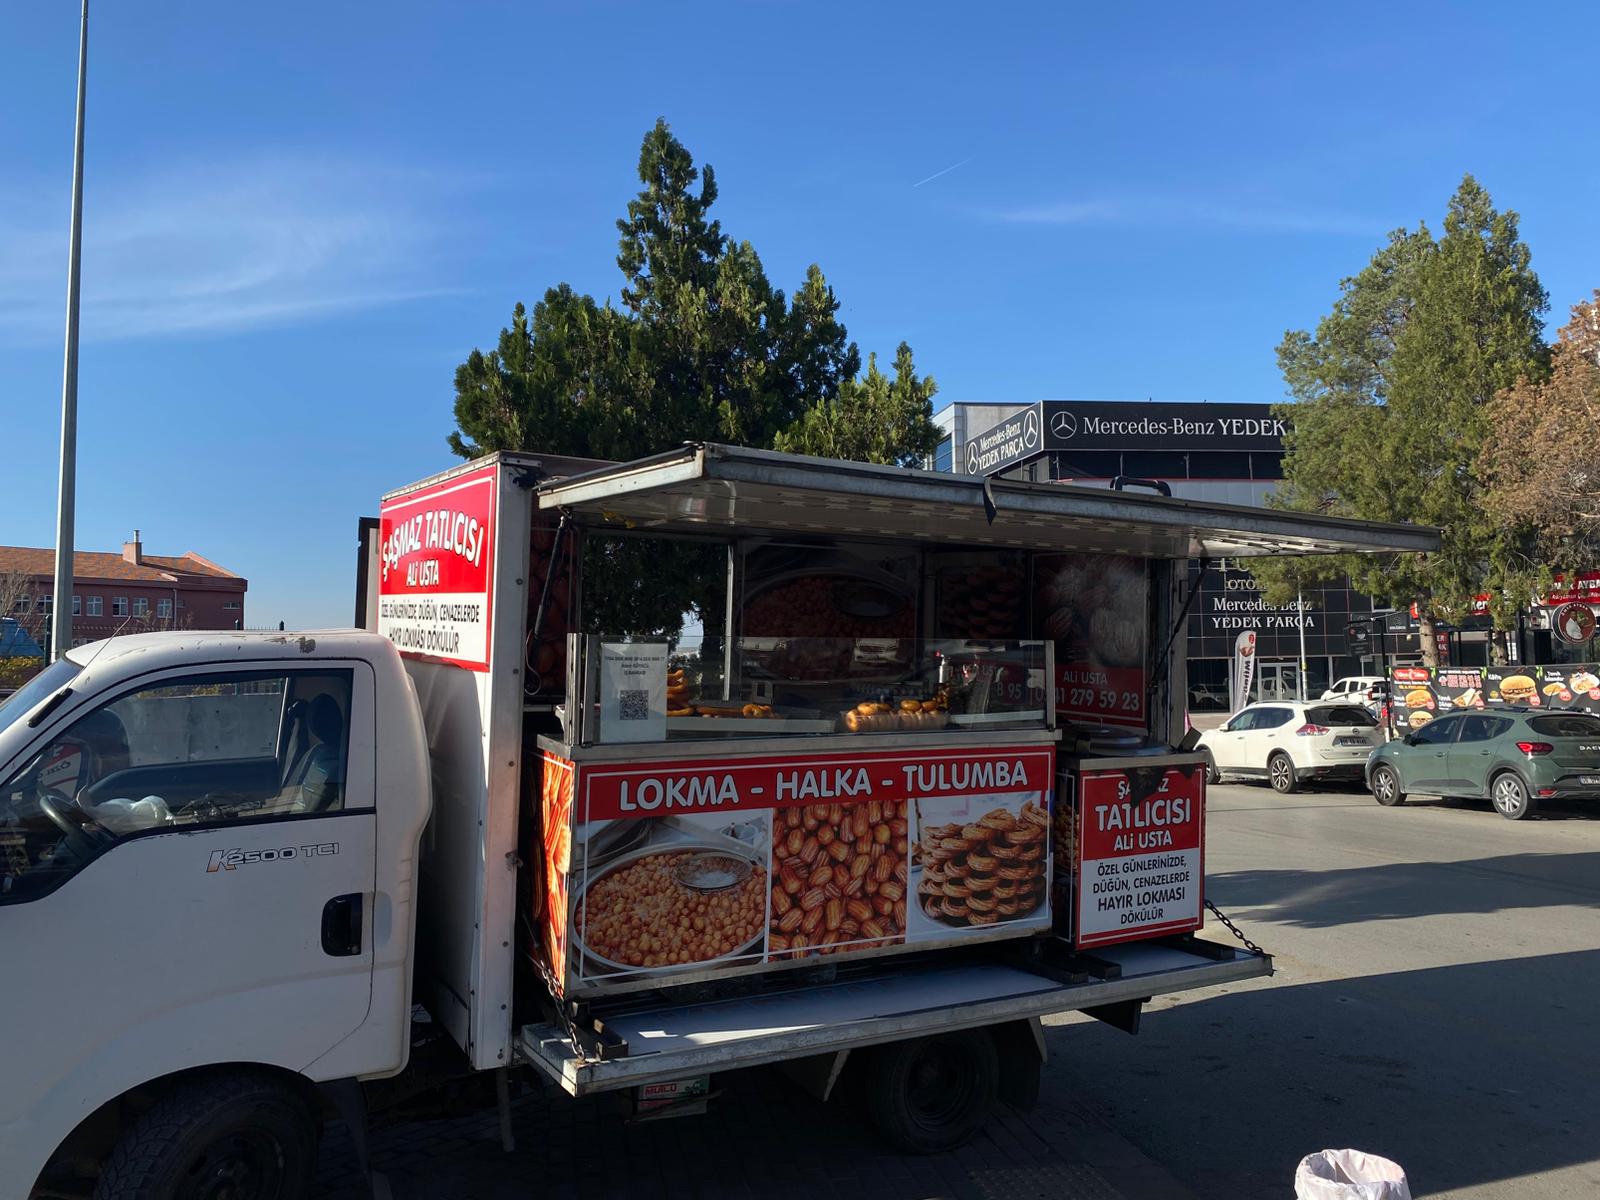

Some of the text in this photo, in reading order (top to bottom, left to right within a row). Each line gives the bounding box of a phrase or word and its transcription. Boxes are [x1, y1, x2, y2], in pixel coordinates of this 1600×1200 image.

[980, 422, 1021, 453] Mercedes-Benz
[1083, 416, 1287, 436] Mercedes-Benz YEDEK
[978, 437, 1024, 470] YEDEK PARÇA
[382, 509, 484, 582] ŞAŞMAZ TATLICISI
[419, 559, 440, 587] USTA
[440, 604, 480, 623] CENAZELERDE
[1212, 617, 1262, 629] YEDEK
[1081, 671, 1108, 686] USTA
[1008, 683, 1023, 699] 95
[1070, 687, 1094, 707] 279
[1098, 689, 1117, 709] 59
[1121, 692, 1140, 712] 23
[619, 773, 739, 811] LOKMA
[776, 766, 872, 800] HALKA
[901, 760, 1028, 792] TULUMBA
[1095, 798, 1191, 831] TATLICISI
[1138, 830, 1173, 850] USTA
[206, 842, 340, 873] K2500 TCI
[1097, 855, 1187, 876] ÖZEL GÜNLERİNİZDE,
[1093, 871, 1190, 894] DÜĞÜN, CENAZELERDE
[1098, 887, 1185, 912] HAYIR LOKMASI
[1120, 908, 1164, 924] DÖKÜLÜR
